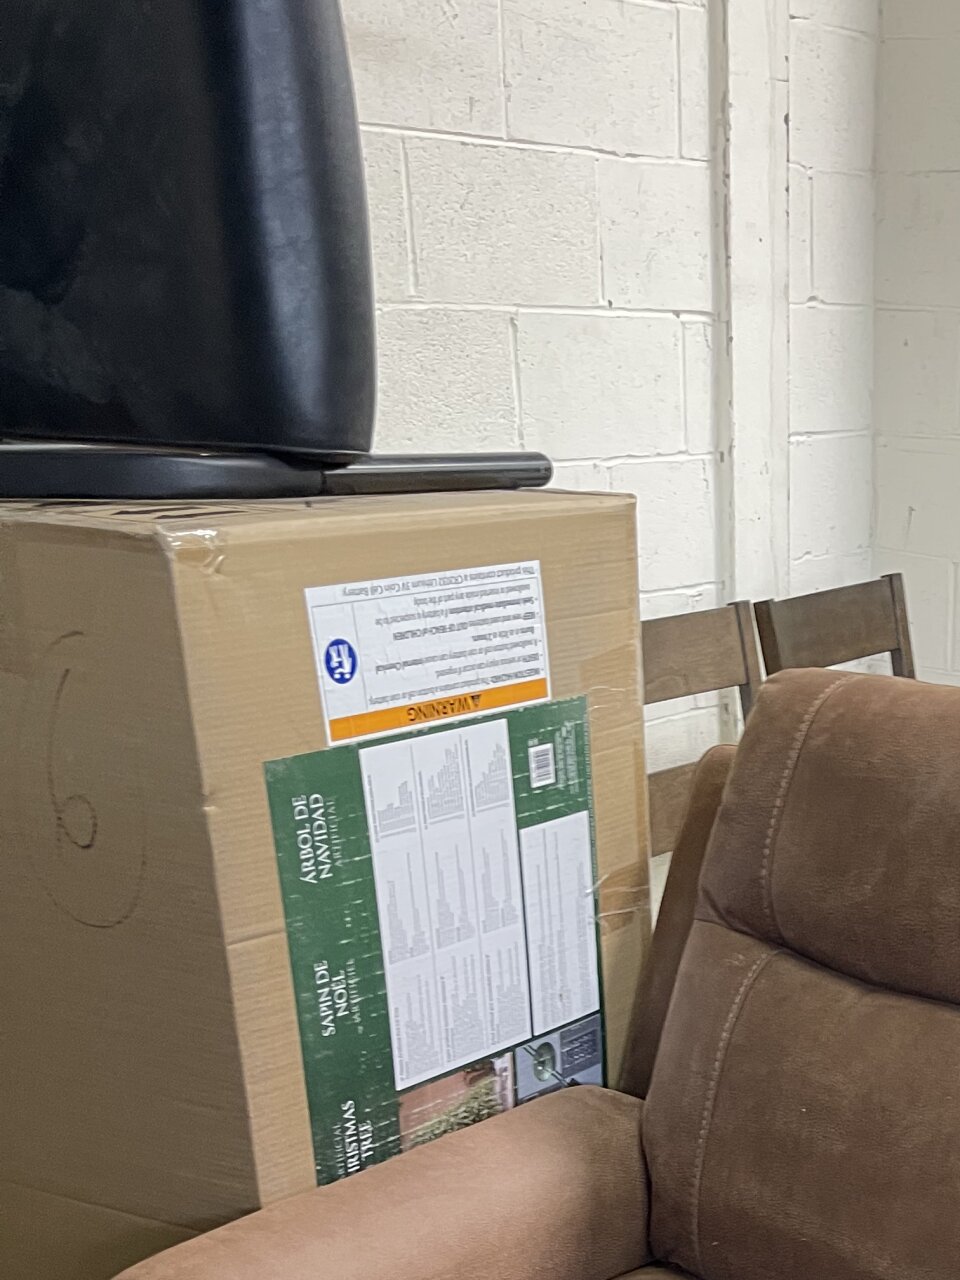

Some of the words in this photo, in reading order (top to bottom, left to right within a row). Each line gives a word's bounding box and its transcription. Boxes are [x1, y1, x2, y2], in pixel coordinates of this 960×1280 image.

[405, 695, 469, 723] WARNING
[291, 794, 309, 820] DE
[295, 823, 319, 884] ÁRBOL
[308, 793, 333, 879] NAVIDAD
[313, 960, 330, 984] DE
[316, 987, 336, 1037] SAPIN
[357, 1120, 374, 1161] TREE
